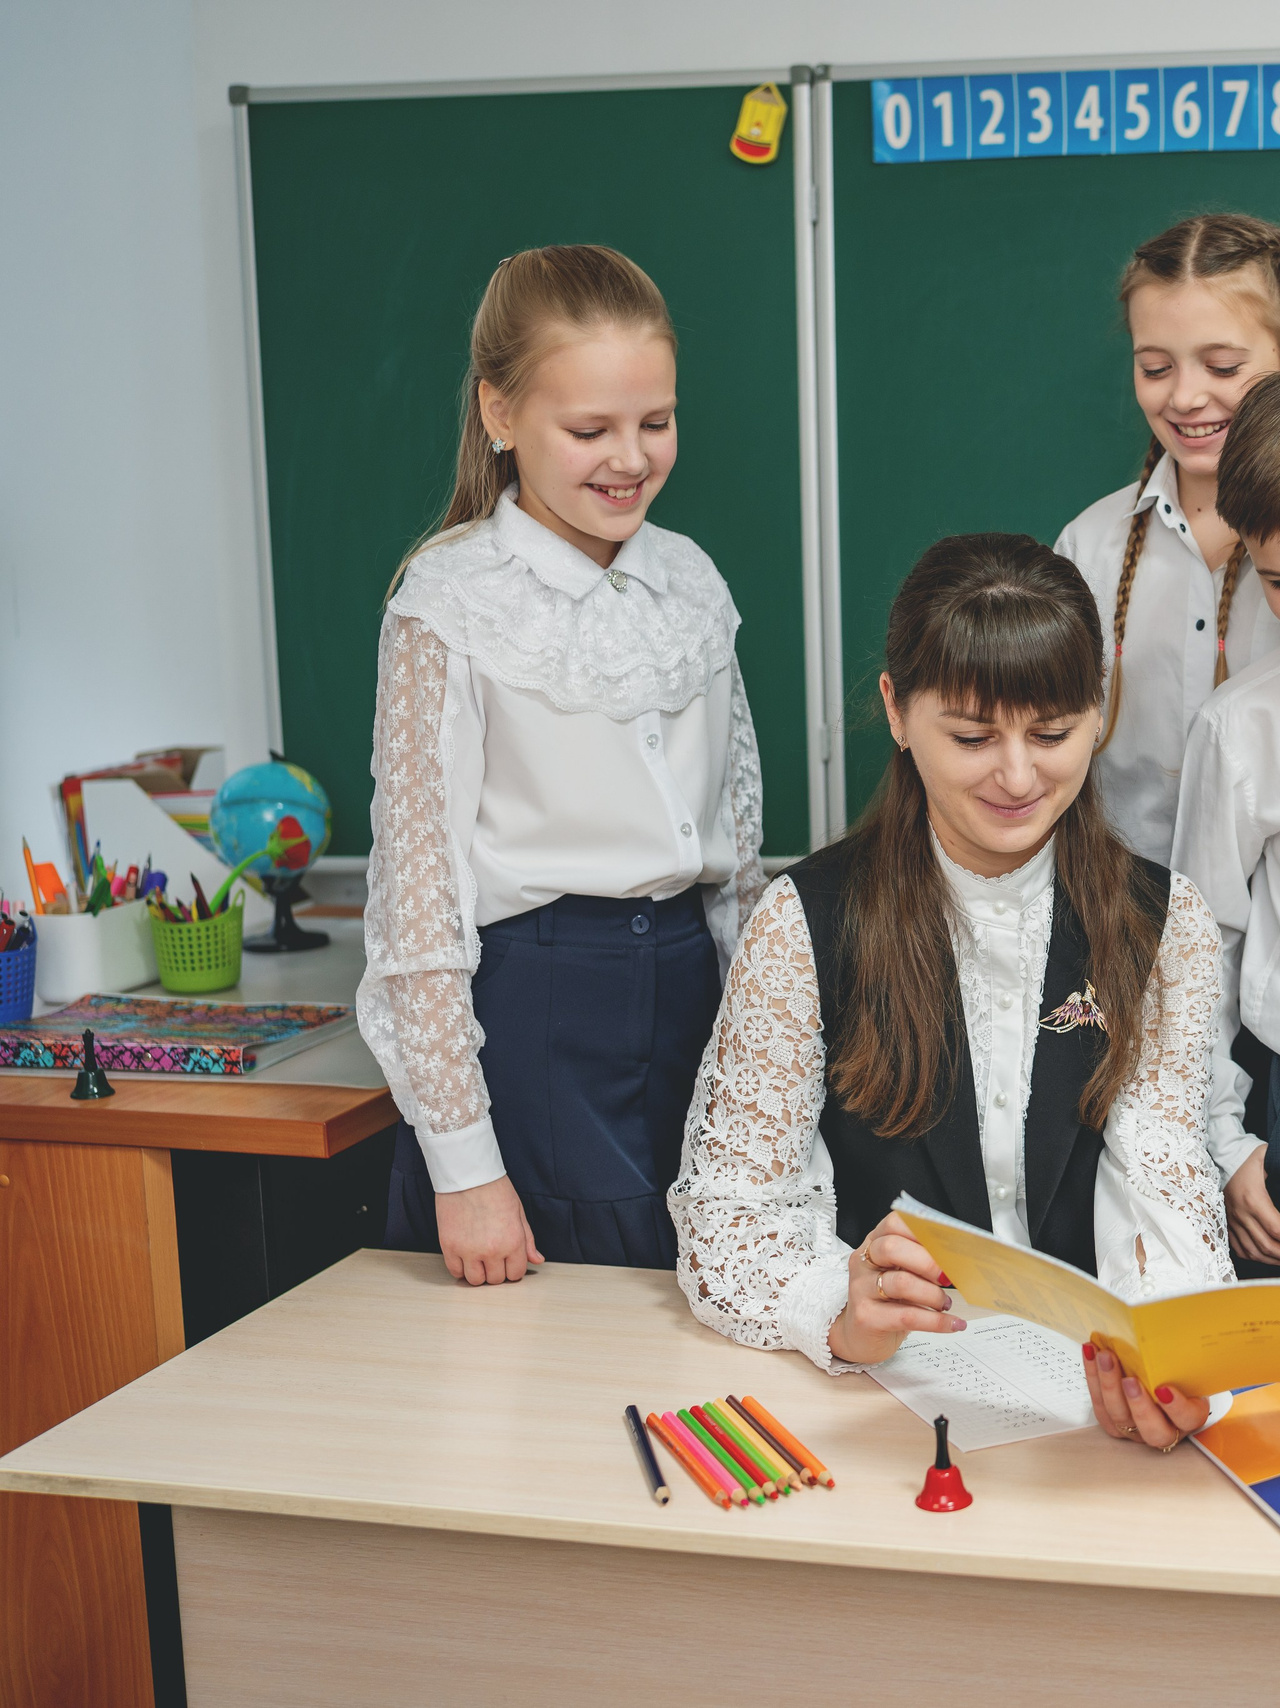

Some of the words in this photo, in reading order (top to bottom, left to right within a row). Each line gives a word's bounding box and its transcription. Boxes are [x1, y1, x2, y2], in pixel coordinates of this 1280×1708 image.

[884, 95, 910, 148] 0
[934, 93, 952, 145] 1
[981, 90, 1004, 144] 2
[1029, 88, 1051, 142] 3
[1076, 86, 1102, 140] 4
[1126, 85, 1148, 139] 5
[1174, 83, 1200, 137] 6
[1224, 81, 1247, 136] 7
